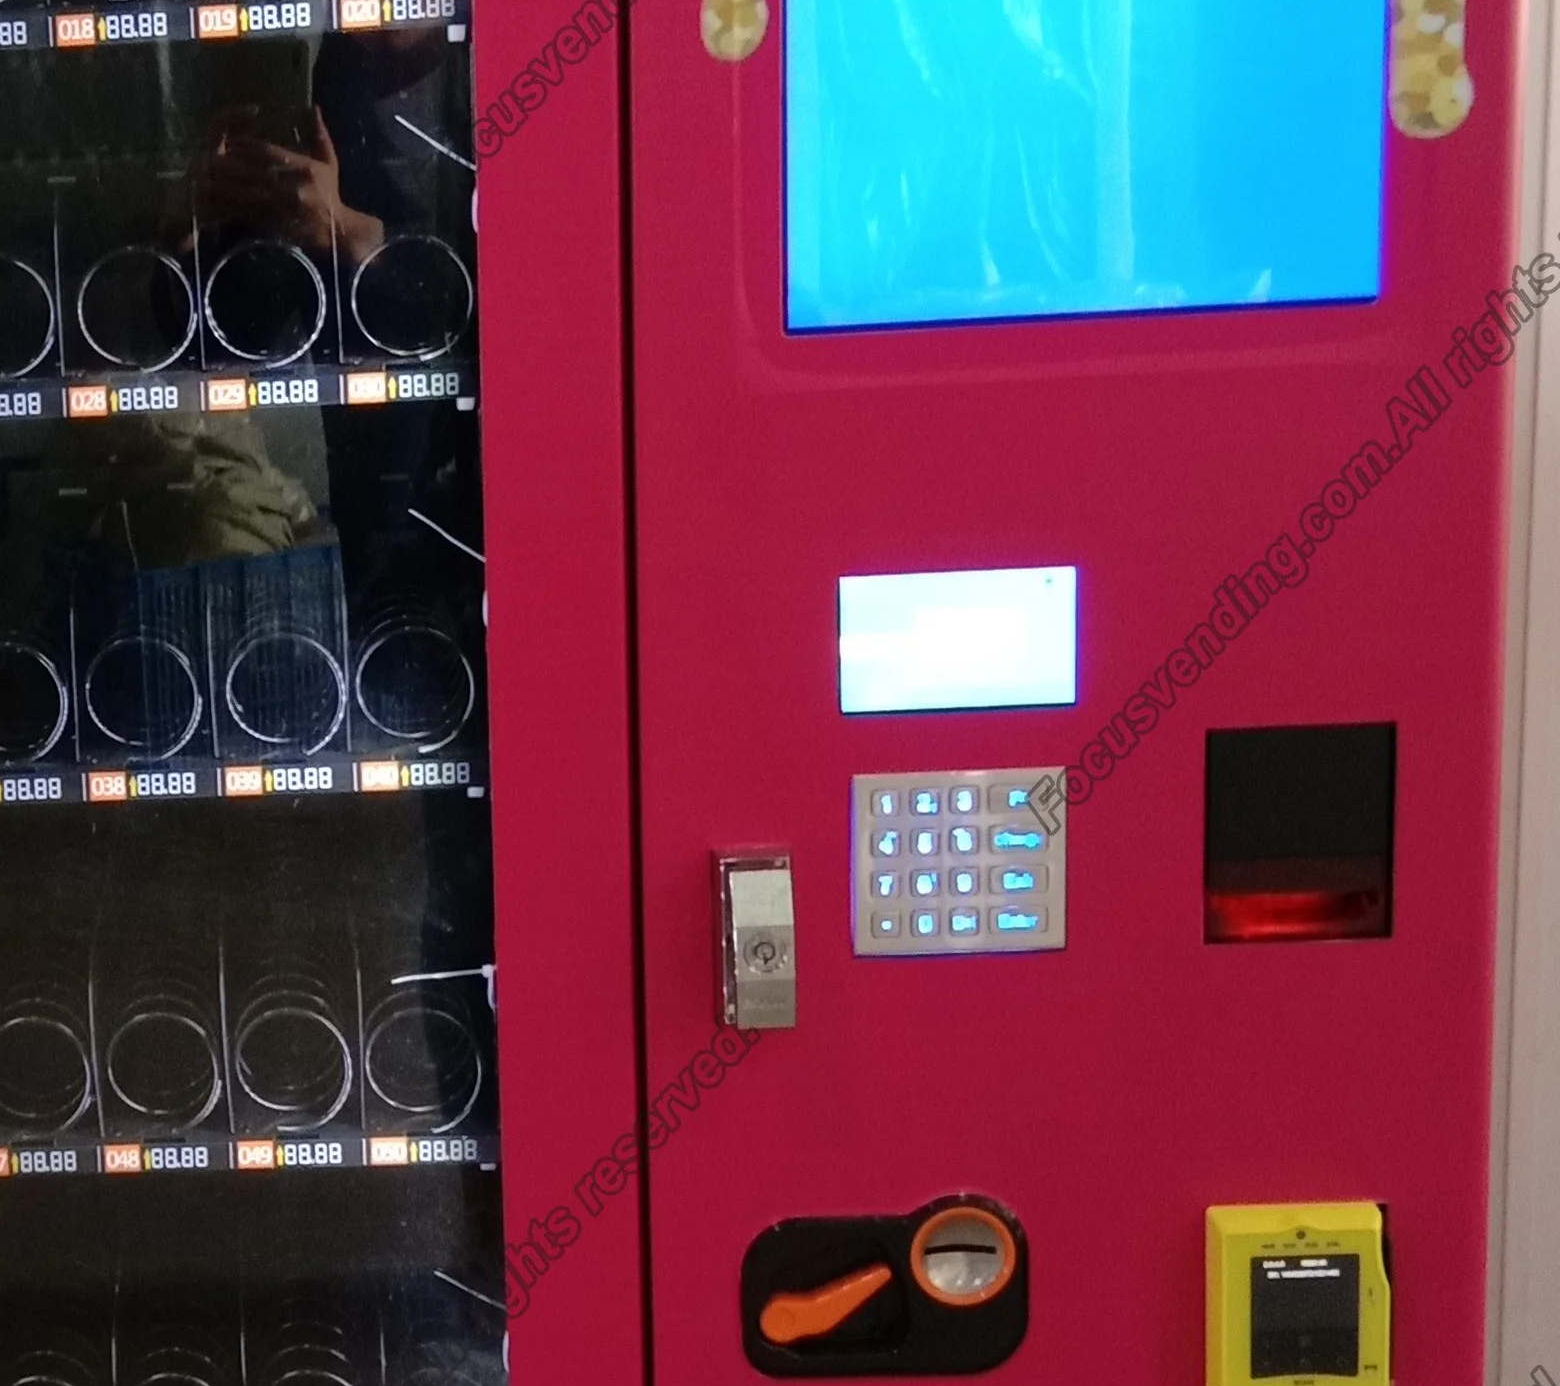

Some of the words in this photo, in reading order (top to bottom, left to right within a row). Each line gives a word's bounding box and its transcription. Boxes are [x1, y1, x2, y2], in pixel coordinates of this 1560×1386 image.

[59, 19, 93, 41] 018
[106, 12, 167, 39] 88.88
[200, 9, 234, 31] 019
[249, 2, 310, 29] 88.88
[258, 378, 318, 404] 88.88
[398, 372, 459, 397] 88.88
[72, 389, 106, 411] 028
[118, 385, 178, 410] 88.88
[91, 776, 124, 797] 038
[136, 771, 196, 796] 88.88
[226, 771, 260, 792] 039
[272, 766, 332, 791] 88.88
[410, 761, 469, 786] 88.88
[3, 777, 61, 801] 88.88
[20, 1150, 77, 1174] 88.88
[106, 1148, 139, 1169] 048
[150, 1145, 208, 1170] 88.88
[239, 1144, 271, 1165] 049
[284, 1141, 342, 1165] 88.88
[419, 1137, 478, 1162] 88.88
